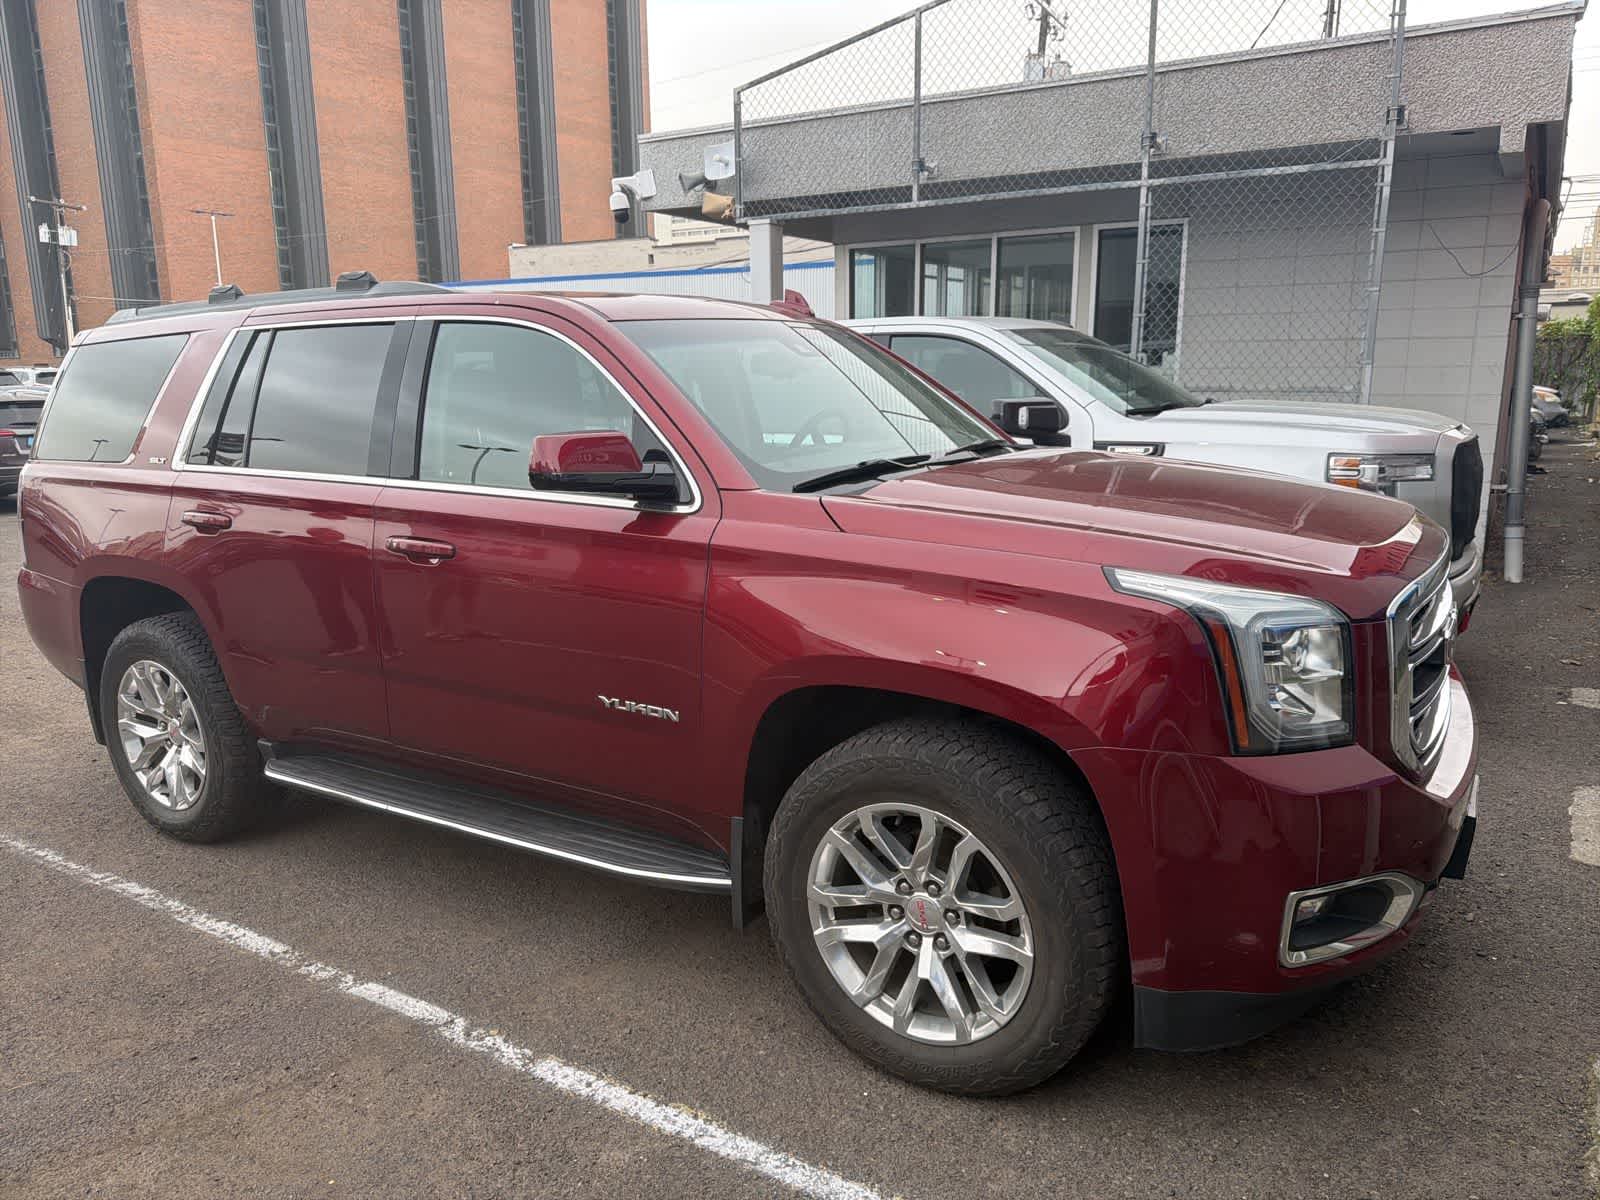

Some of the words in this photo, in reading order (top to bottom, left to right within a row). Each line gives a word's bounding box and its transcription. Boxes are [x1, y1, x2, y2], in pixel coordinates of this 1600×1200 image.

[149, 456, 168, 464] SLT
[598, 695, 679, 722] YUKON
[916, 900, 928, 929] GMC
